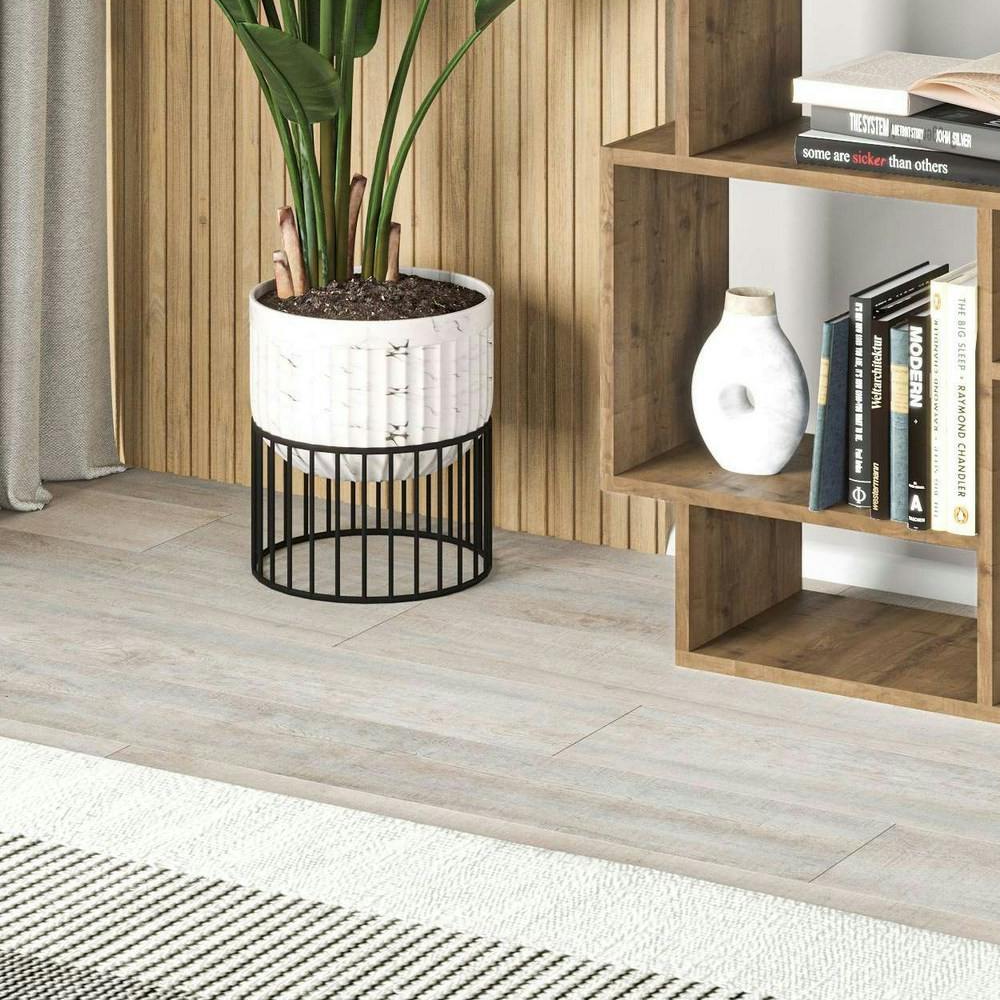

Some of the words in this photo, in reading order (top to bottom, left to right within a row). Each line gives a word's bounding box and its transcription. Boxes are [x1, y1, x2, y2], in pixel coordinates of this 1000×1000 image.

[849, 112, 864, 132] THE
[863, 115, 890, 137] SYSTEM
[802, 147, 831, 161] some
[834, 151, 850, 163] are
[853, 151, 887, 167] sicker
[888, 154, 912, 171] than
[915, 158, 948, 174] others
[957, 298, 967, 316] THE
[957, 319, 967, 339] BIG
[908, 326, 923, 408] MODERN
[957, 342, 967, 371] SLEEP
[871, 335, 883, 410] Weltarchitektur
[957, 385, 967, 439] RAYMOND
[957, 442, 967, 497] CHANDLER
[872, 462, 880, 511] westermann
[910, 494, 923, 511] A
